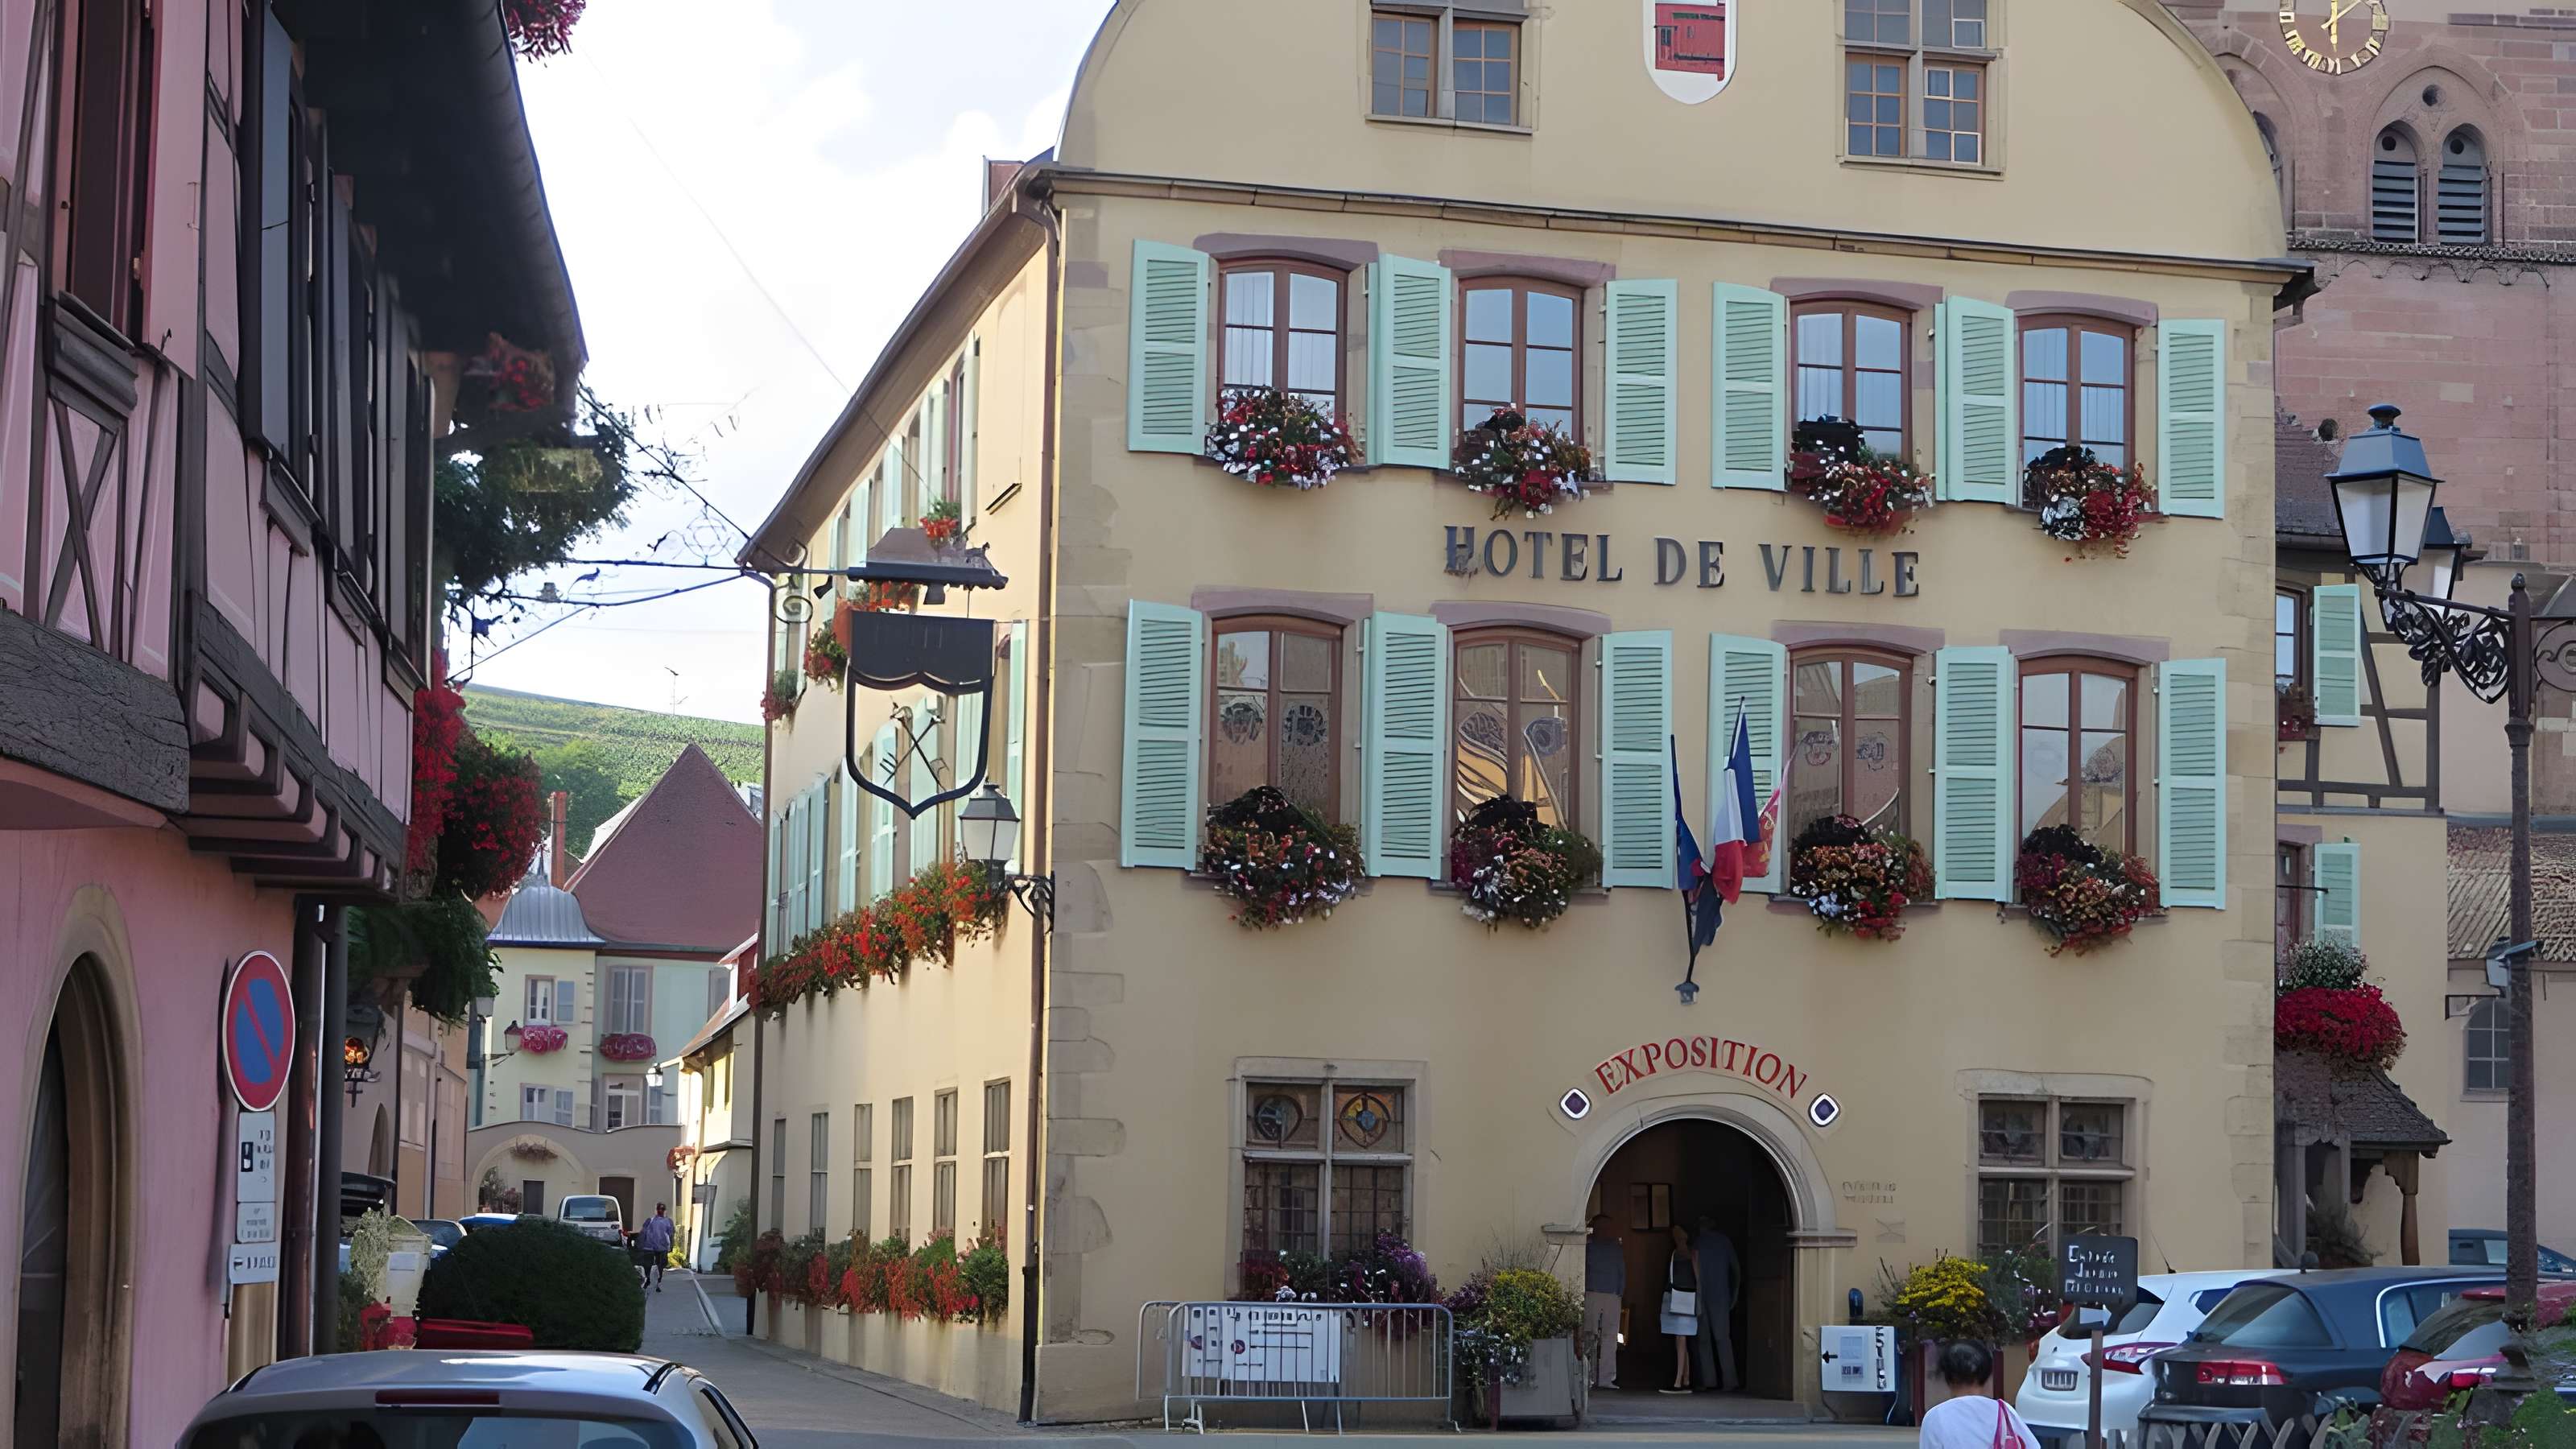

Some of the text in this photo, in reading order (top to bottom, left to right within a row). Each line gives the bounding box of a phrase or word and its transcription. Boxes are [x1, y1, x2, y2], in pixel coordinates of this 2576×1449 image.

[1443, 525, 1919, 597] HOTEL DE VILLE
[1595, 1036, 1807, 1099] EXPOSITION
